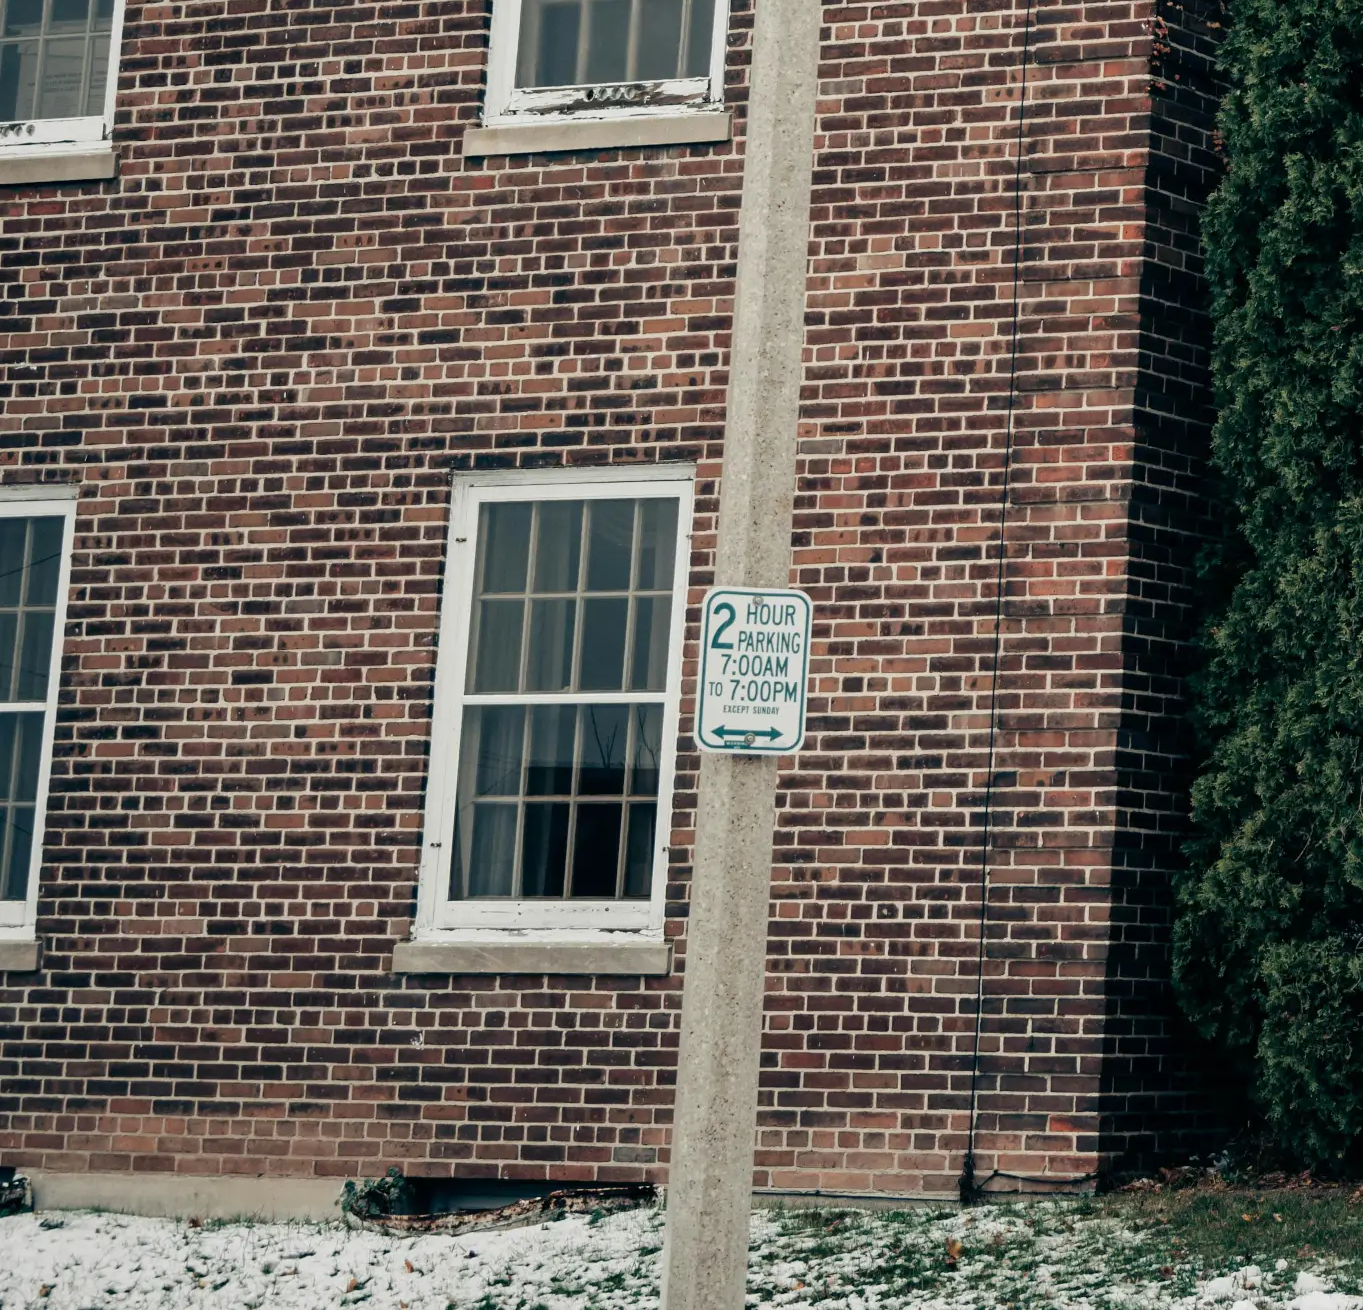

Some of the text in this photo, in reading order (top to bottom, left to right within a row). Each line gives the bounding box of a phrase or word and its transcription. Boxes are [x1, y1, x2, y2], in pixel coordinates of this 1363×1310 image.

[710, 601, 796, 650] 2 HOUR
[737, 630, 801, 654] PARKING
[721, 653, 789, 678] 7:00AM
[708, 679, 798, 703] TO 7:00PM
[723, 704, 780, 715] EXCEPT SUNDAY
